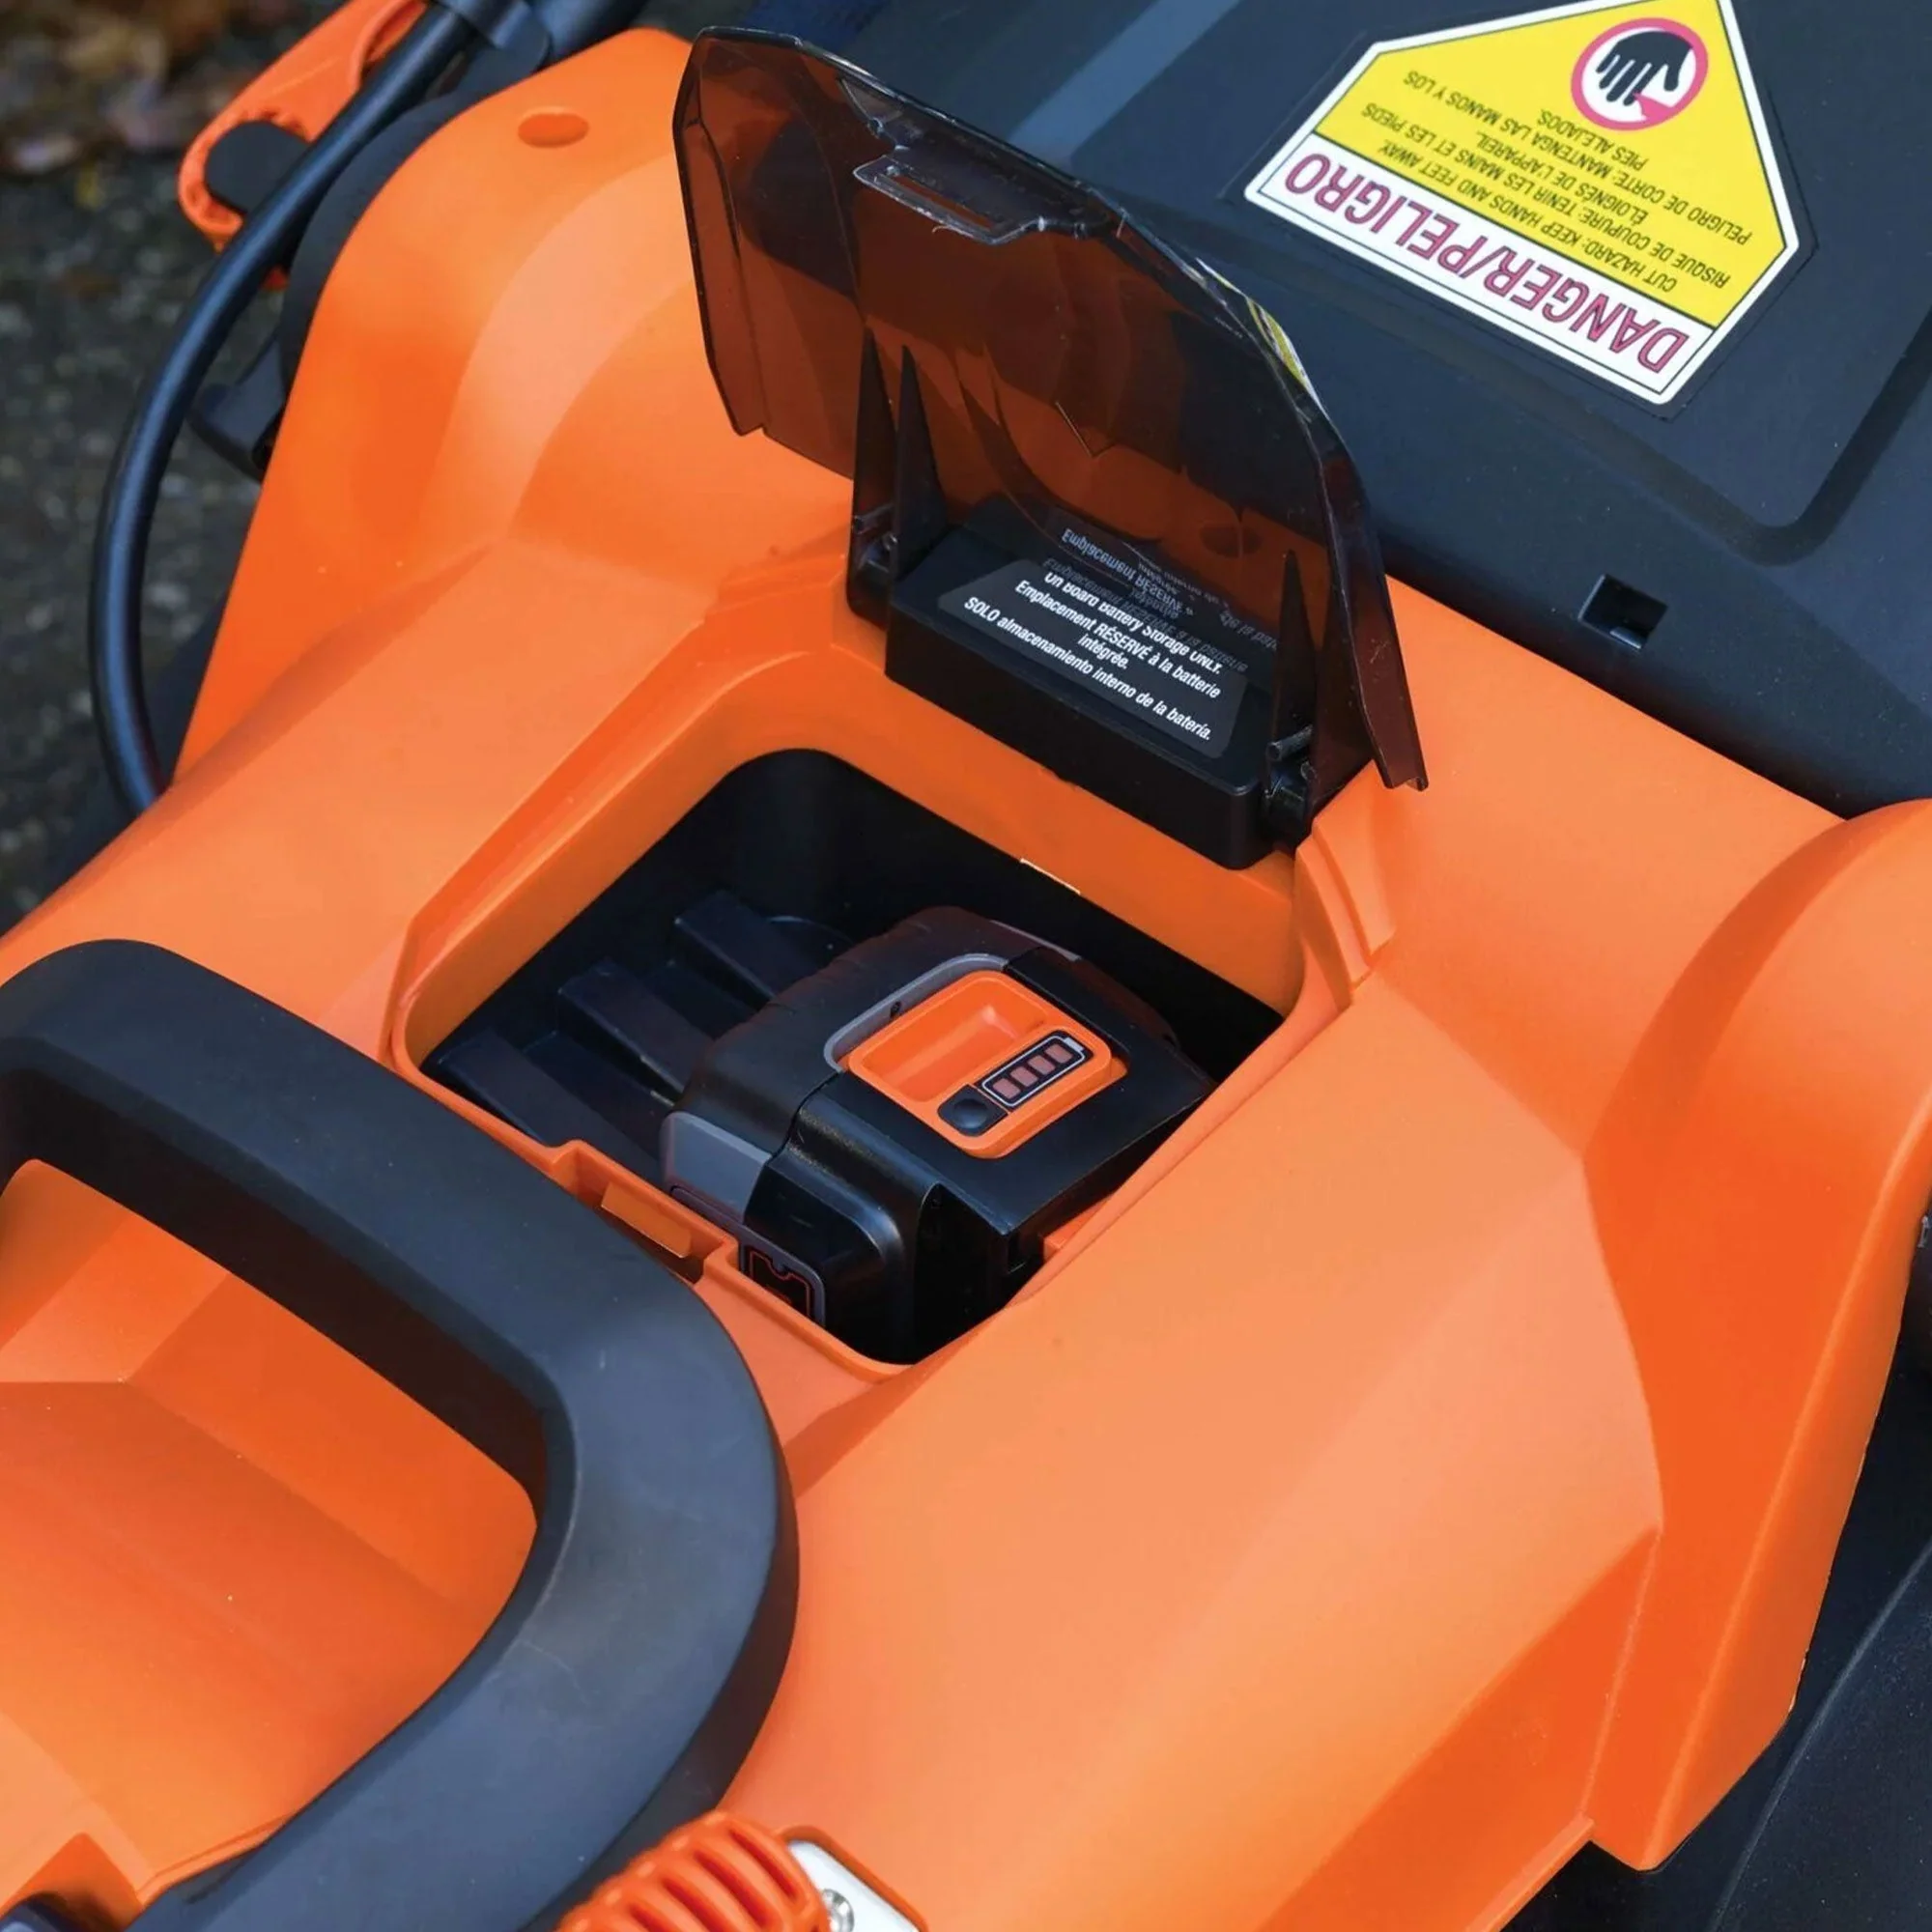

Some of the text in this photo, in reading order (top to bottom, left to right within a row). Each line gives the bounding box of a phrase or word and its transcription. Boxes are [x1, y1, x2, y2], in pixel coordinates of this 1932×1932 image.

[1403, 71, 1752, 245] PELIGRO DE CORTE: MANTENGA LAS MANOS Y LOS
[1537, 109, 1648, 171] PIES ALEJADOS.
[1418, 161, 1459, 186] FEET
[1457, 179, 1492, 201] AND
[1551, 170, 1577, 190] DE
[1361, 102, 1730, 288] RISQUE DE COUPURE: TENIR LES MAINS ET LES PIEDS
[1489, 194, 1543, 227] HANDS
[1574, 182, 1648, 225] ÉLOIGNÉS
[1540, 221, 1581, 246] KEEP
[1284, 153, 1690, 374] DANGER/PELIGRO
[1581, 238, 1646, 277] HAZARD:
[1641, 270, 1677, 292] CUT
[1014, 580, 1096, 630] Emplacement
[1093, 622, 1152, 659] RÉSERVÉ
[1148, 652, 1160, 665] à
[1157, 657, 1173, 672] la
[1171, 665, 1220, 697] batterie
[1077, 633, 1128, 668] intégrée.
[964, 596, 1210, 740] SOLO almacenamiento interno de la batería.
